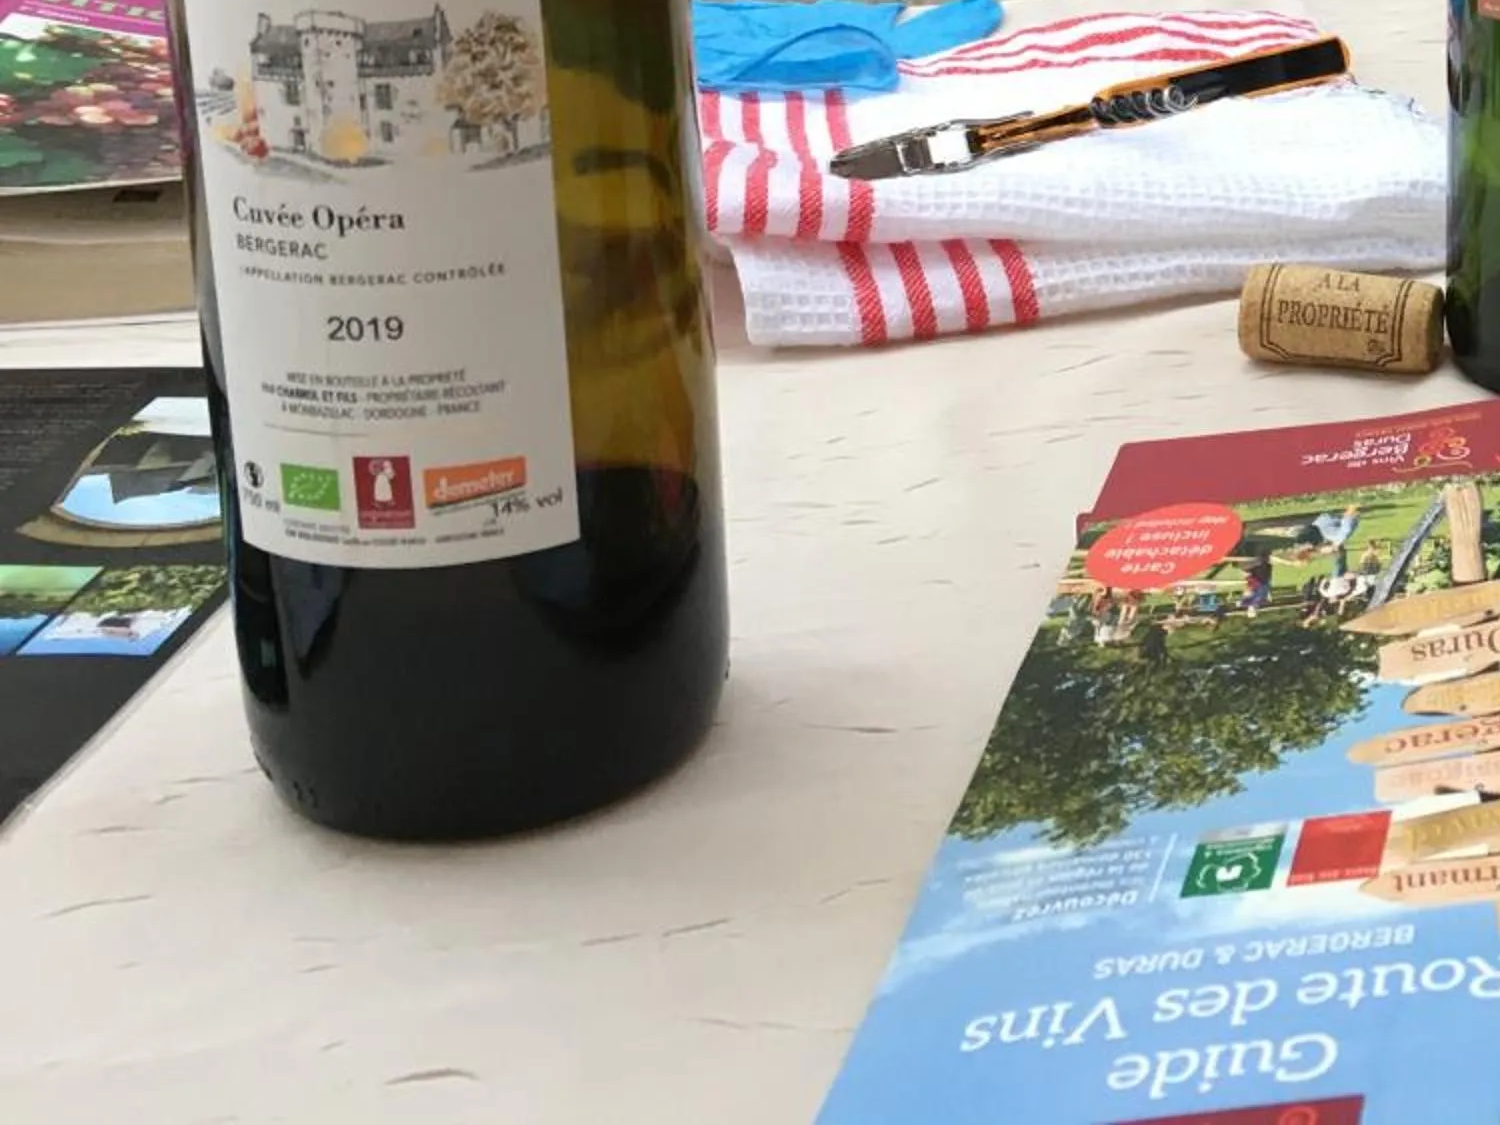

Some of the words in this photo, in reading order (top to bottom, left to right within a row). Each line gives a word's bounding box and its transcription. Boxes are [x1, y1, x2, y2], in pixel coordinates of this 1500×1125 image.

[233, 195, 304, 230] Cuvée
[312, 203, 405, 237] Opéra
[236, 232, 329, 261] BERGERAC
[244, 265, 324, 286] APPELLATION
[329, 273, 407, 287] BERGERAC
[1338, 272, 1361, 293] LA
[326, 315, 405, 342] 2019
[1277, 298, 1389, 334] PROPRIÉTÉ
[535, 485, 564, 508] vol
[1120, 561, 1177, 575] Carte
[1011, 889, 1139, 923] Découvrez
[1213, 943, 1237, 967] &
[1243, 923, 1416, 964] BERGERAC
[1093, 947, 1206, 980] DURAS
[1151, 974, 1280, 1026] des
[958, 993, 1129, 1053] Vins
[1104, 1032, 1341, 1100] Guide
